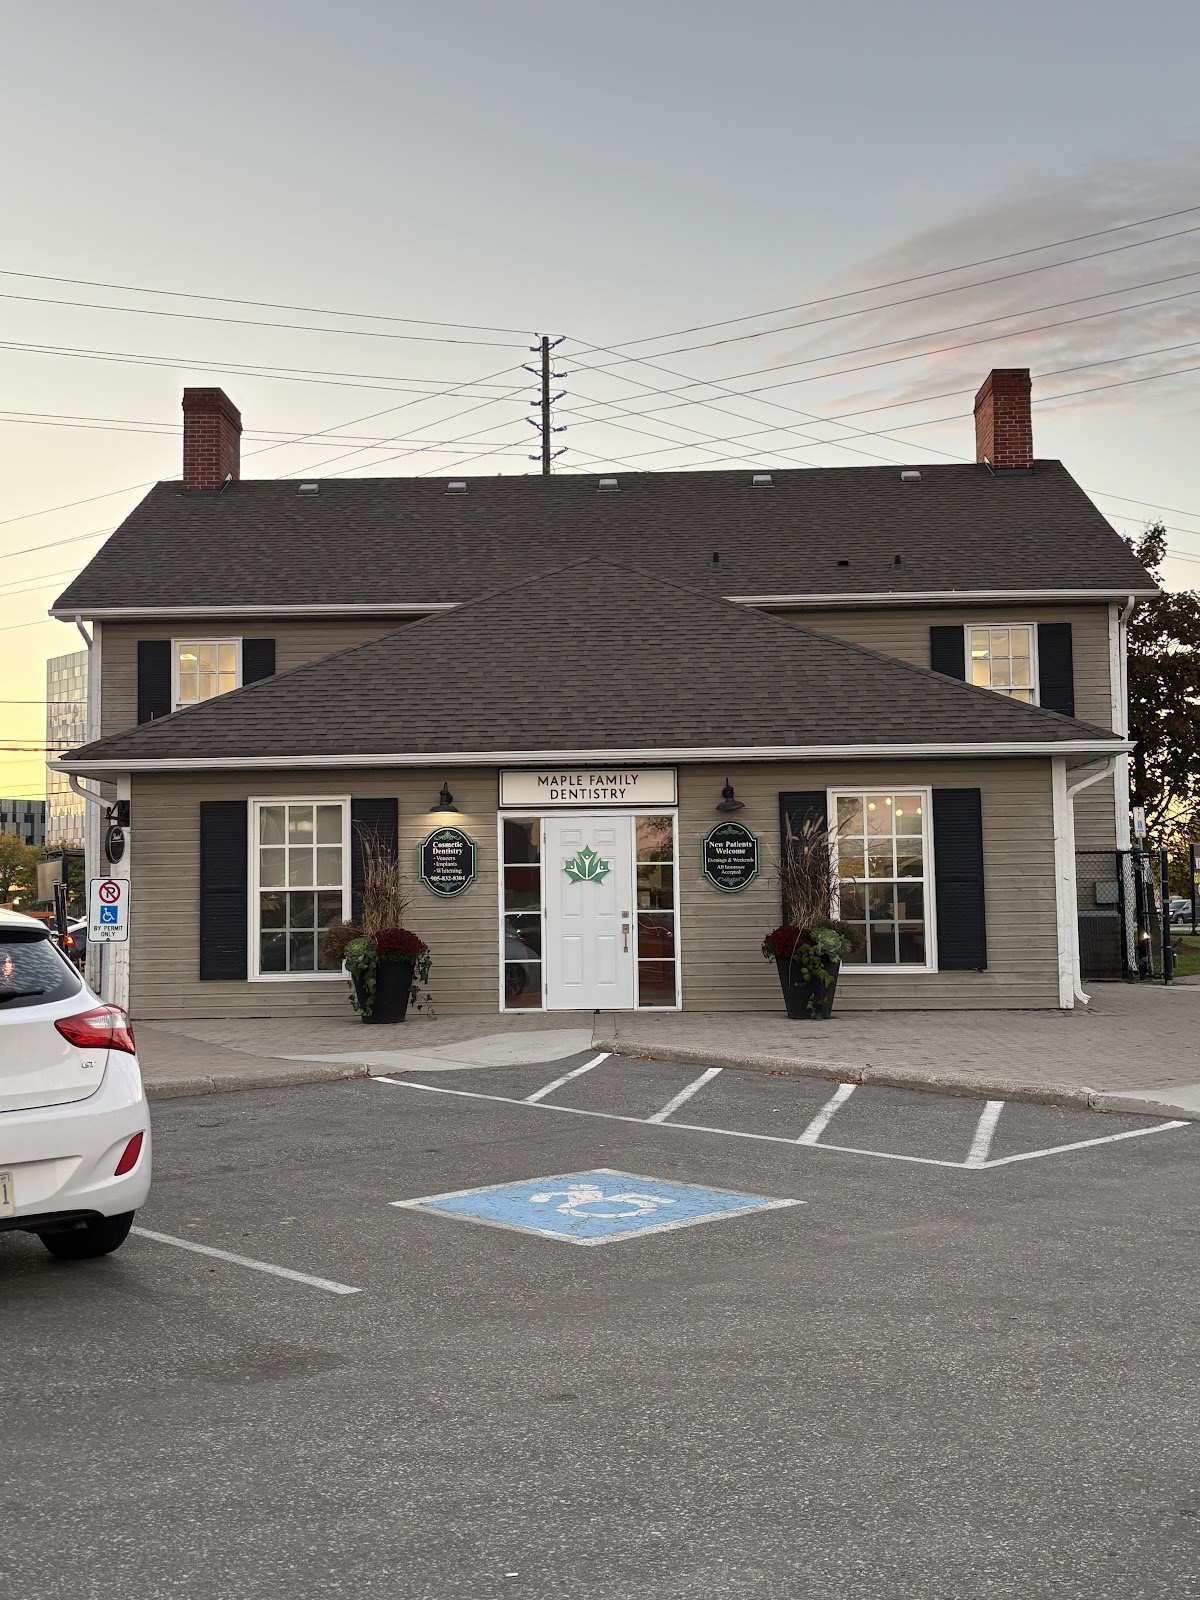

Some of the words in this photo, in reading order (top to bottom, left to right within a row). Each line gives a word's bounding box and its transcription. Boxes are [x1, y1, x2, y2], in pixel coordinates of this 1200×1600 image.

[537, 775, 583, 786] MAPLE
[589, 774, 639, 785] FAMILY
[550, 788, 627, 799] DENTISTRY
